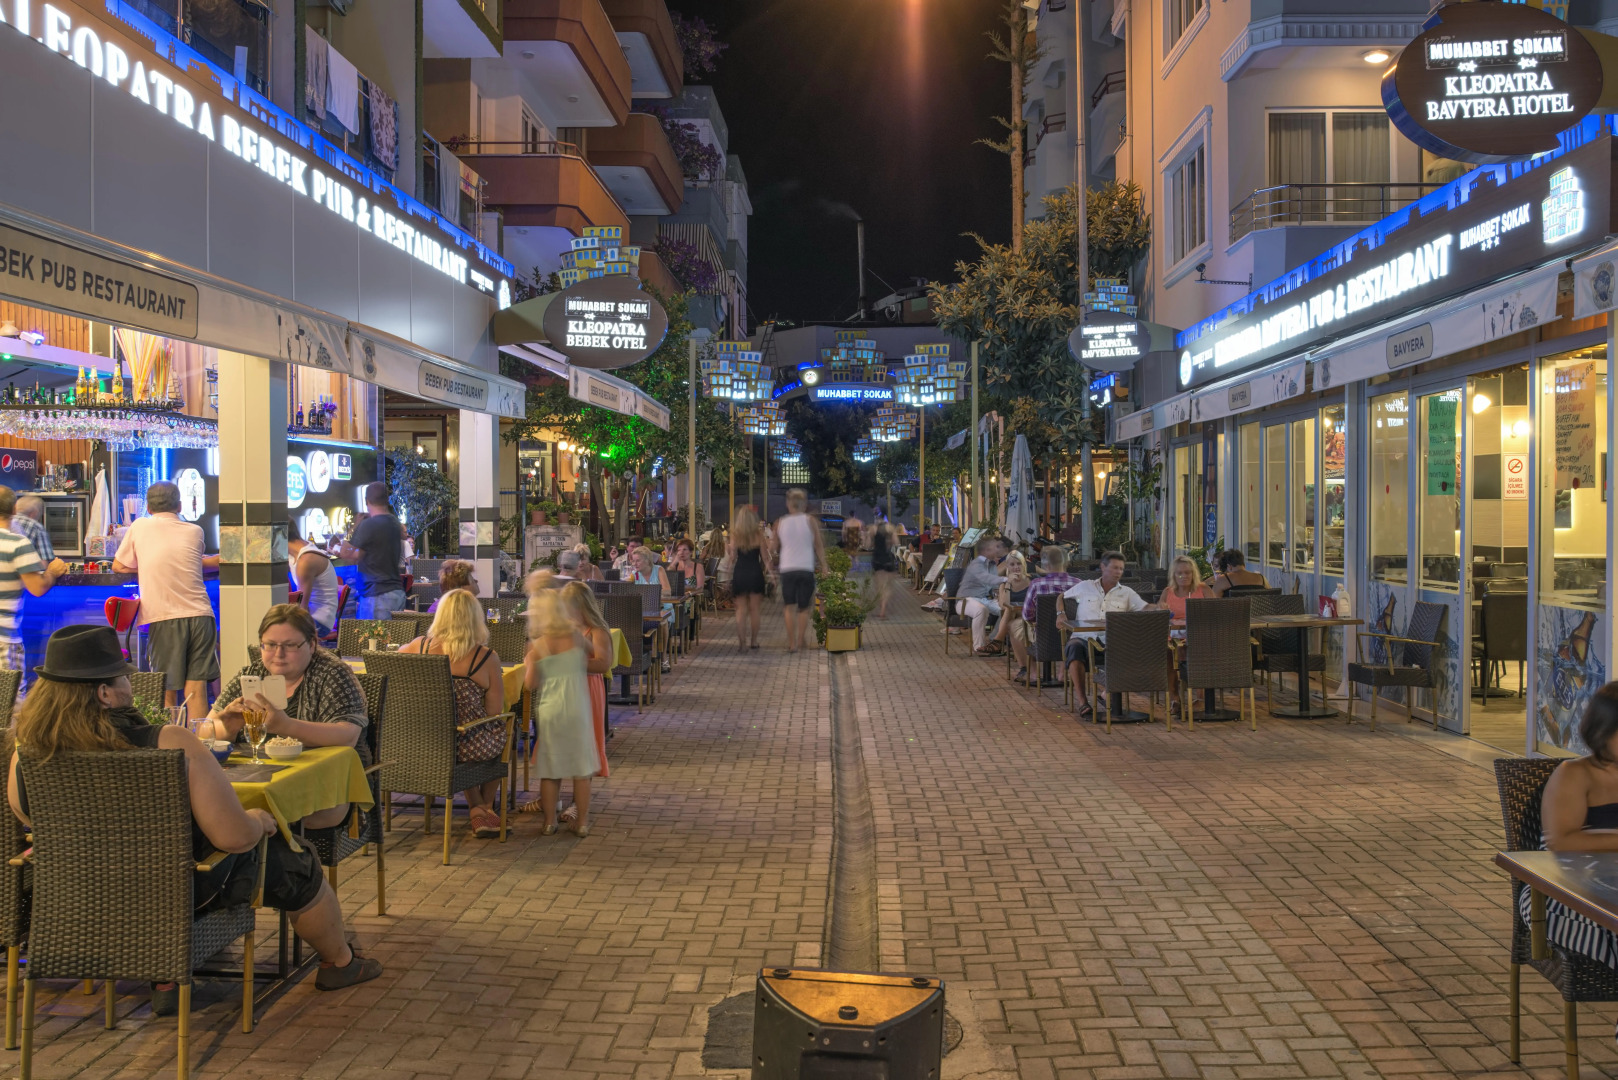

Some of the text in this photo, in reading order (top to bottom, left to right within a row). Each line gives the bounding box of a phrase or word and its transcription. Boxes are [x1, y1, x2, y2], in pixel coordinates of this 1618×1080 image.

[1430, 36, 1564, 60] MUHABBET SOKAK
[1445, 71, 1554, 97] KLEOPATRA
[1426, 93, 1575, 121] BAVYERA HOTEL
[0, 0, 468, 285] LEOPATRA BEBEK PUB & RESTAURANT
[1460, 203, 1530, 250] MUHABBET SOKAK
[41, 258, 77, 292] PUB
[82, 271, 186, 320] RESTAURANT
[1309, 289, 1335, 329] PUB
[1334, 283, 1347, 320] &
[1346, 233, 1453, 314] RESTAURANT
[568, 300, 648, 314] MUHABBET SOKAK
[568, 320, 646, 336] KLEOPATRA
[566, 334, 647, 350] BEBEK OTEL
[1081, 346, 1140, 359] BAVYERA HOTEL
[1088, 338, 1132, 349] KLEOPATRA
[1393, 336, 1425, 357] BAVYERA
[425, 372, 484, 400] BEBEK PUB RESTAURANT
[817, 389, 893, 399] MUHABBET SOKAK
[14, 458, 35, 472] pepsi
[287, 470, 305, 490] EFES
[1556, 672, 1573, 704] EFES
